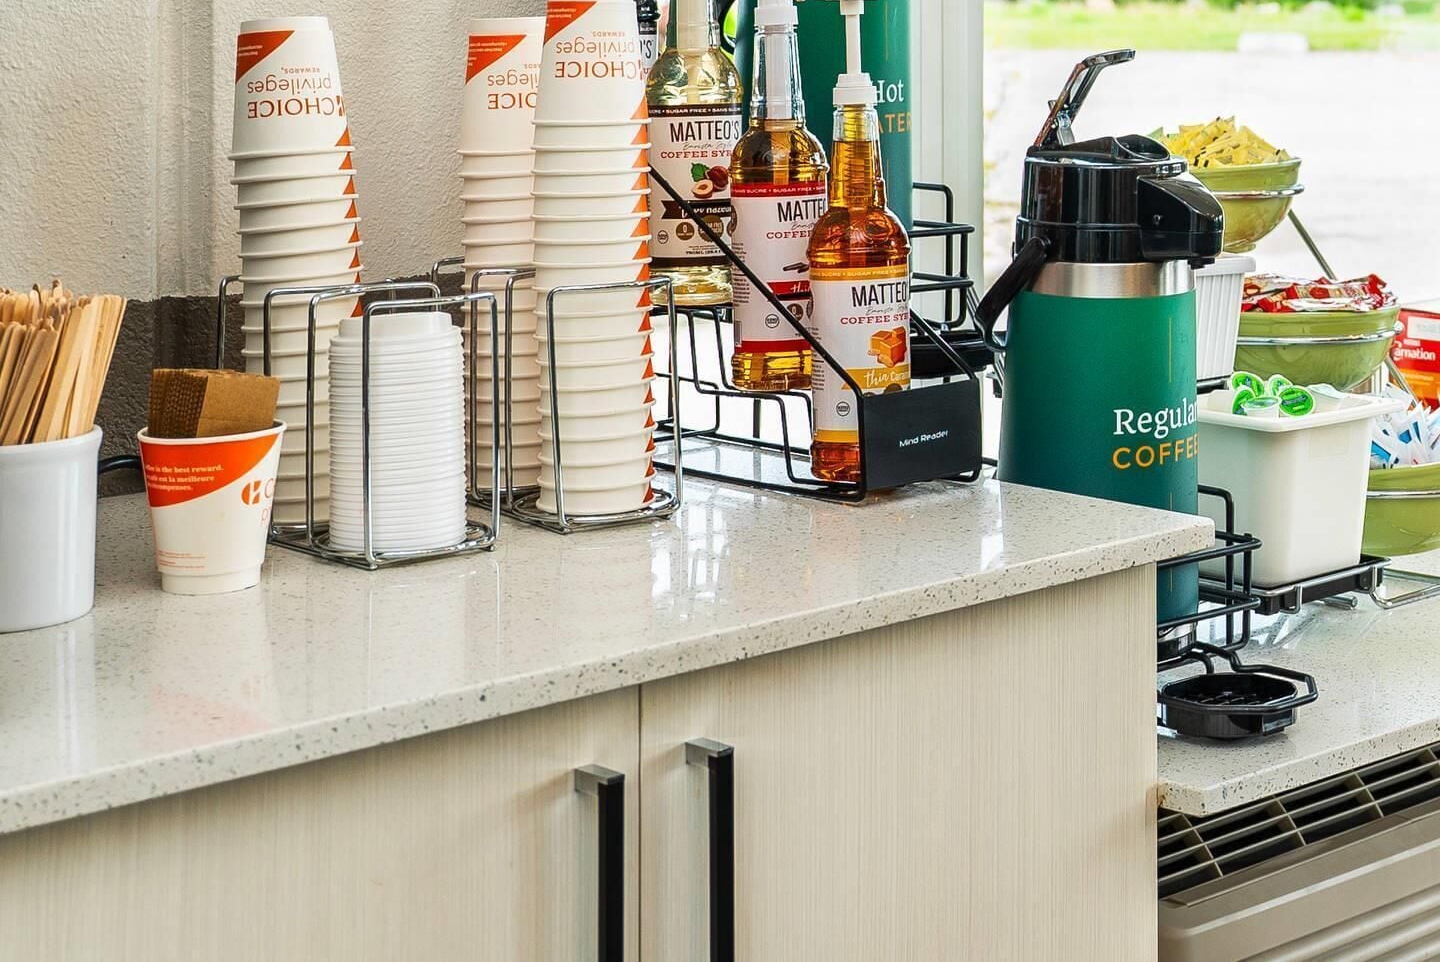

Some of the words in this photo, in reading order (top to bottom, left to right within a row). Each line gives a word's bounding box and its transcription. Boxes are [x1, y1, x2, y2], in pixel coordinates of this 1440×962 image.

[556, 36, 635, 58] privileges
[487, 69, 539, 89] ileges
[554, 61, 637, 79] CHOICE
[247, 73, 331, 95] privileges
[247, 97, 335, 119] CHOICE
[487, 92, 538, 110] OICE
[669, 120, 740, 143] MATTEO'S
[879, 111, 912, 133] TER
[660, 150, 708, 159] COFFEE
[711, 149, 732, 158] SYR
[777, 198, 826, 223] MATTE
[851, 281, 908, 308] MATTEO
[840, 315, 890, 325] COFFEE
[893, 312, 908, 322] SYR
[899, 436, 919, 448] Mind
[920, 429, 949, 443] Reader
[191, 464, 225, 473] reward.
